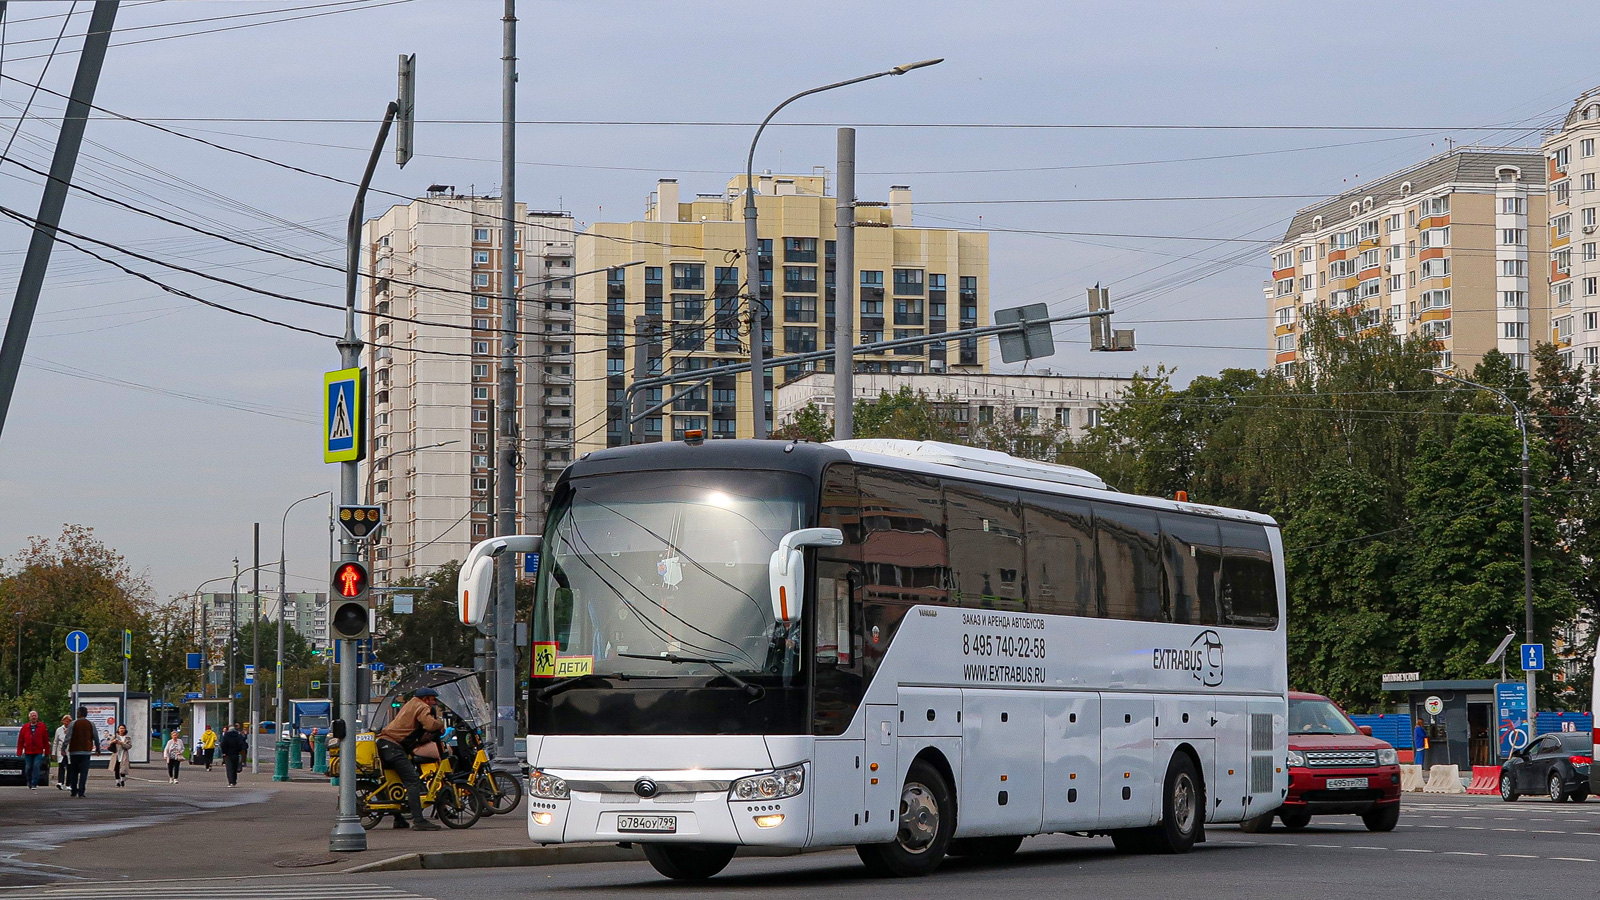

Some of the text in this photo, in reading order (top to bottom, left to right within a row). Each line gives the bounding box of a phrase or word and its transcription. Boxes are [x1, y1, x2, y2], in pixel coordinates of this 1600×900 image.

[962, 613, 1045, 630] ЗАКАЗ И АРЕНДА АВТОБУСОВ
[963, 633, 1046, 659] 8 495 740-22-58
[558, 660, 588, 675] ДЕТИ
[1152, 647, 1203, 672] EXTRABUS
[963, 663, 1046, 683] WWW.EXTRABUS.RU
